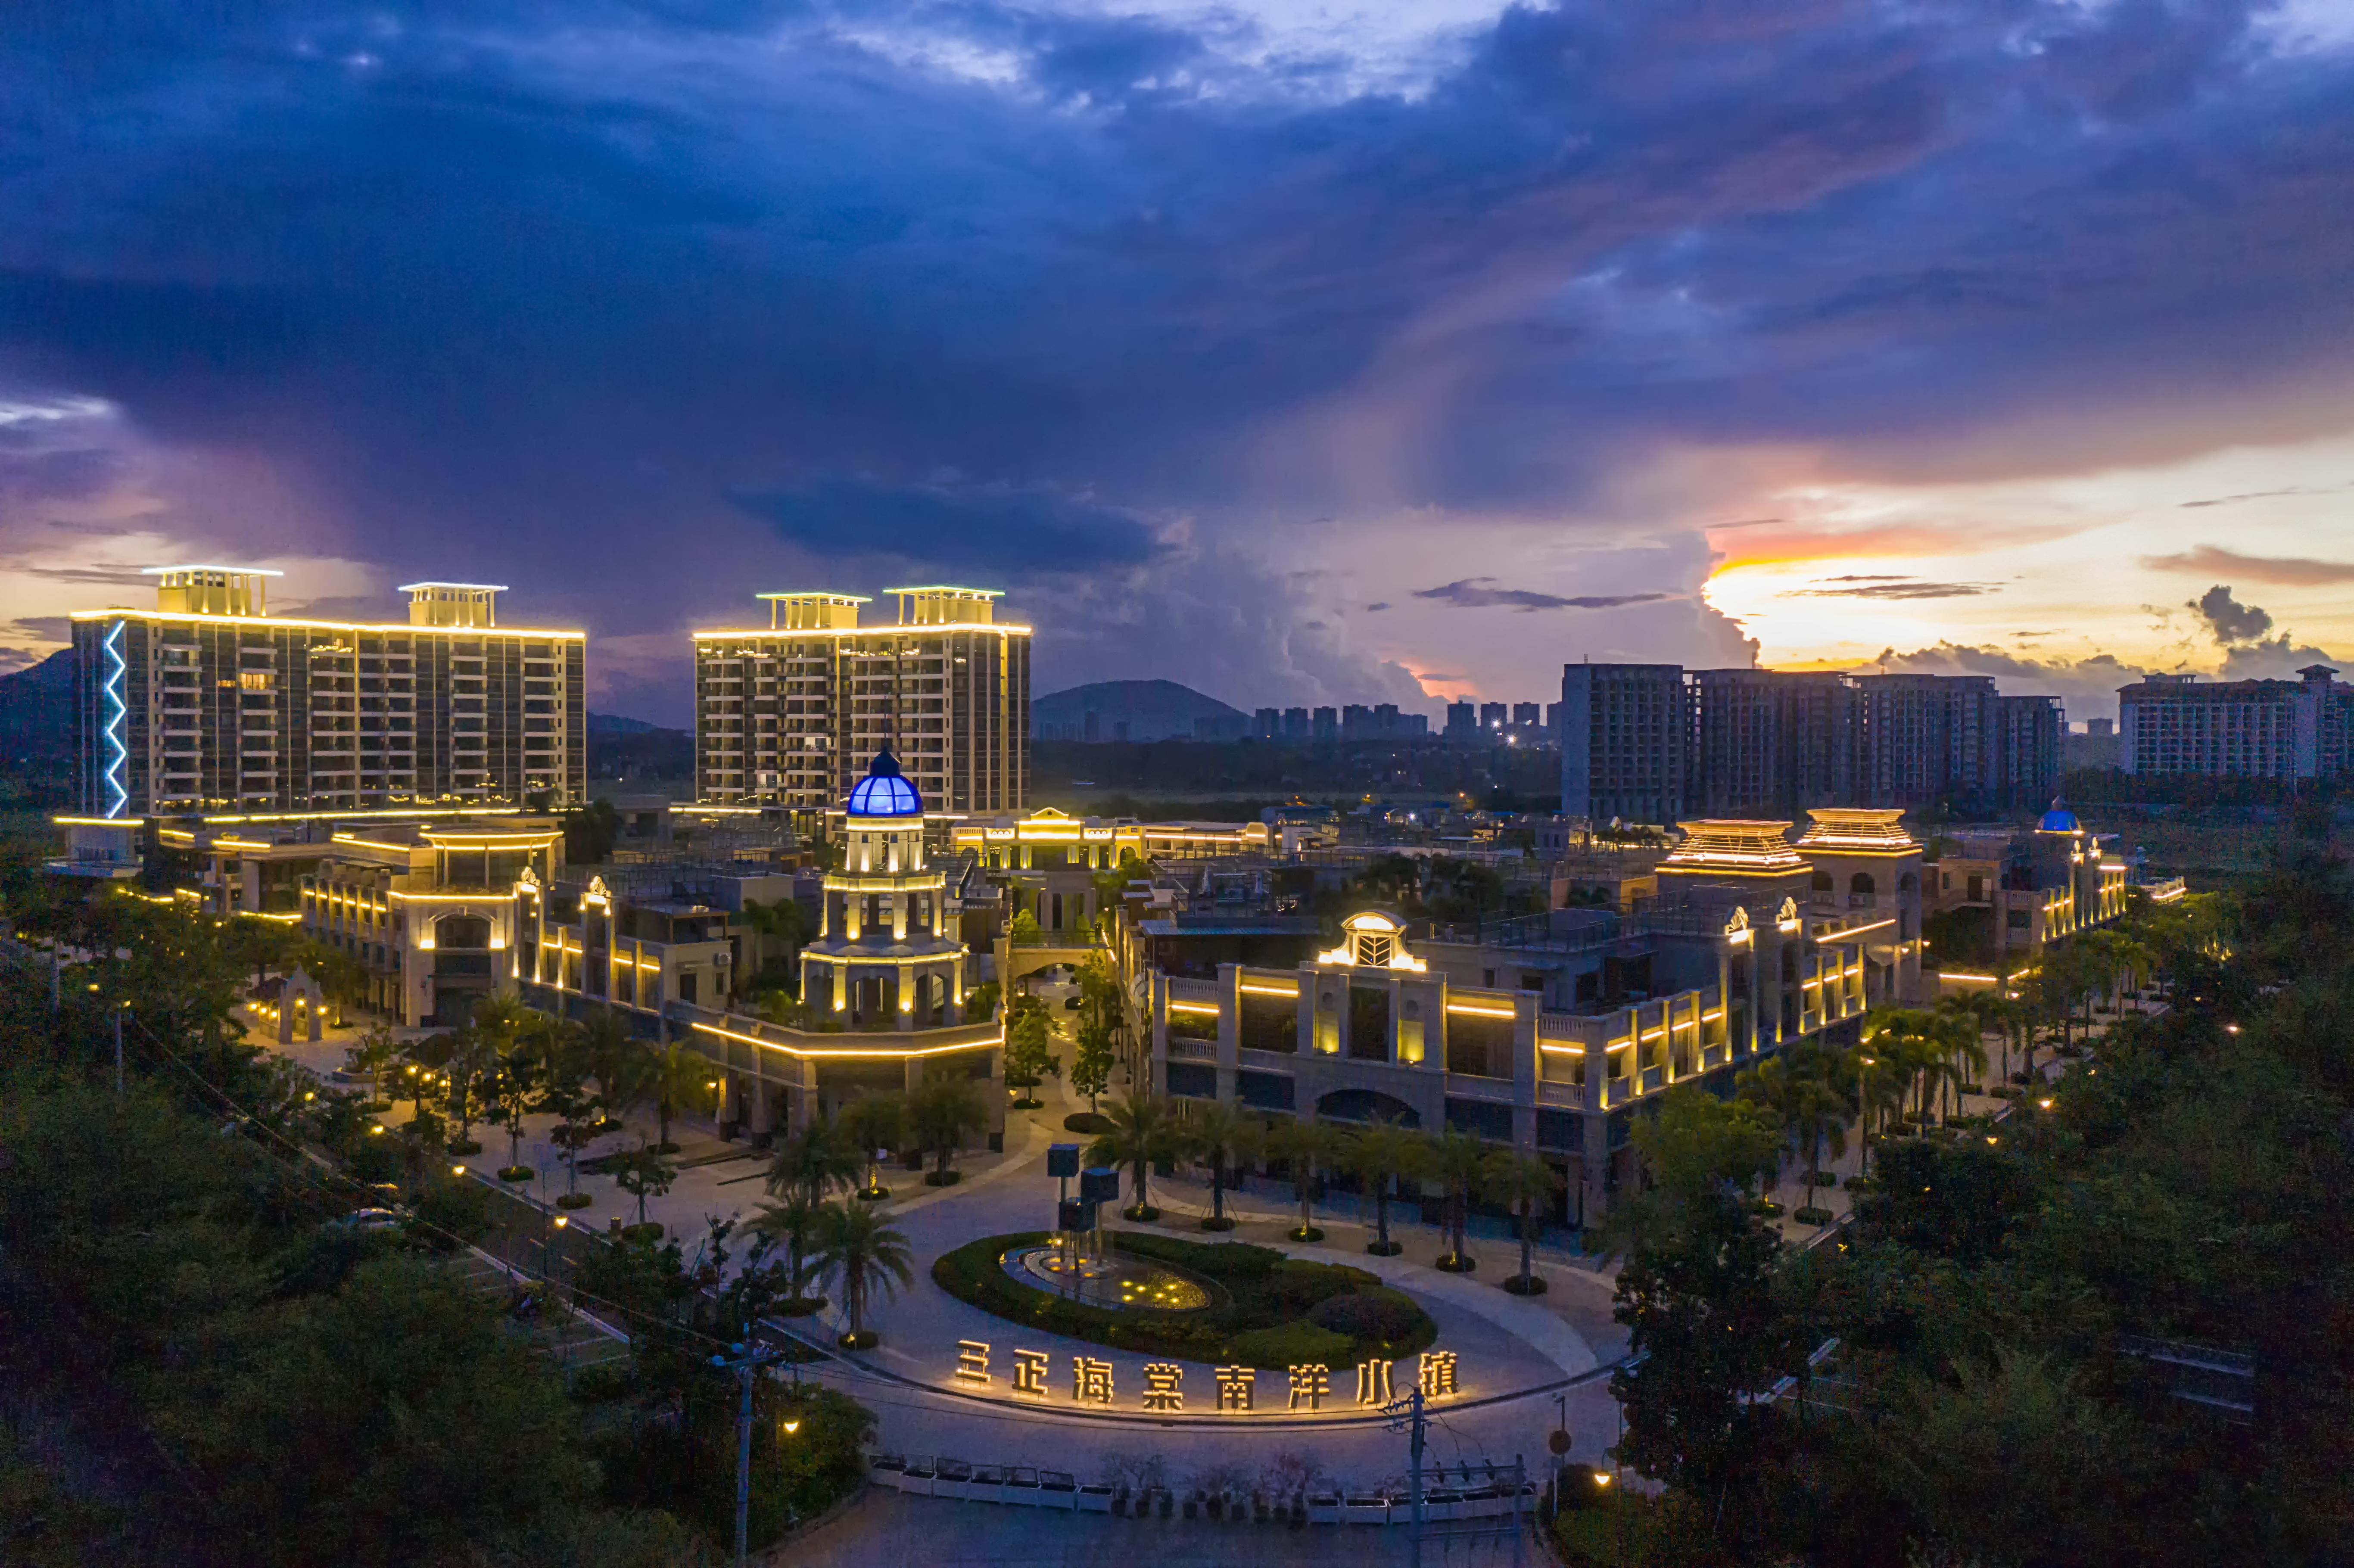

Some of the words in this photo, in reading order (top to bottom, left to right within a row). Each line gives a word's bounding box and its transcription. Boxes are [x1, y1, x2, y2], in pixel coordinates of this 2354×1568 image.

[955, 1340, 1458, 1410] 三正海棠南洋小镇
